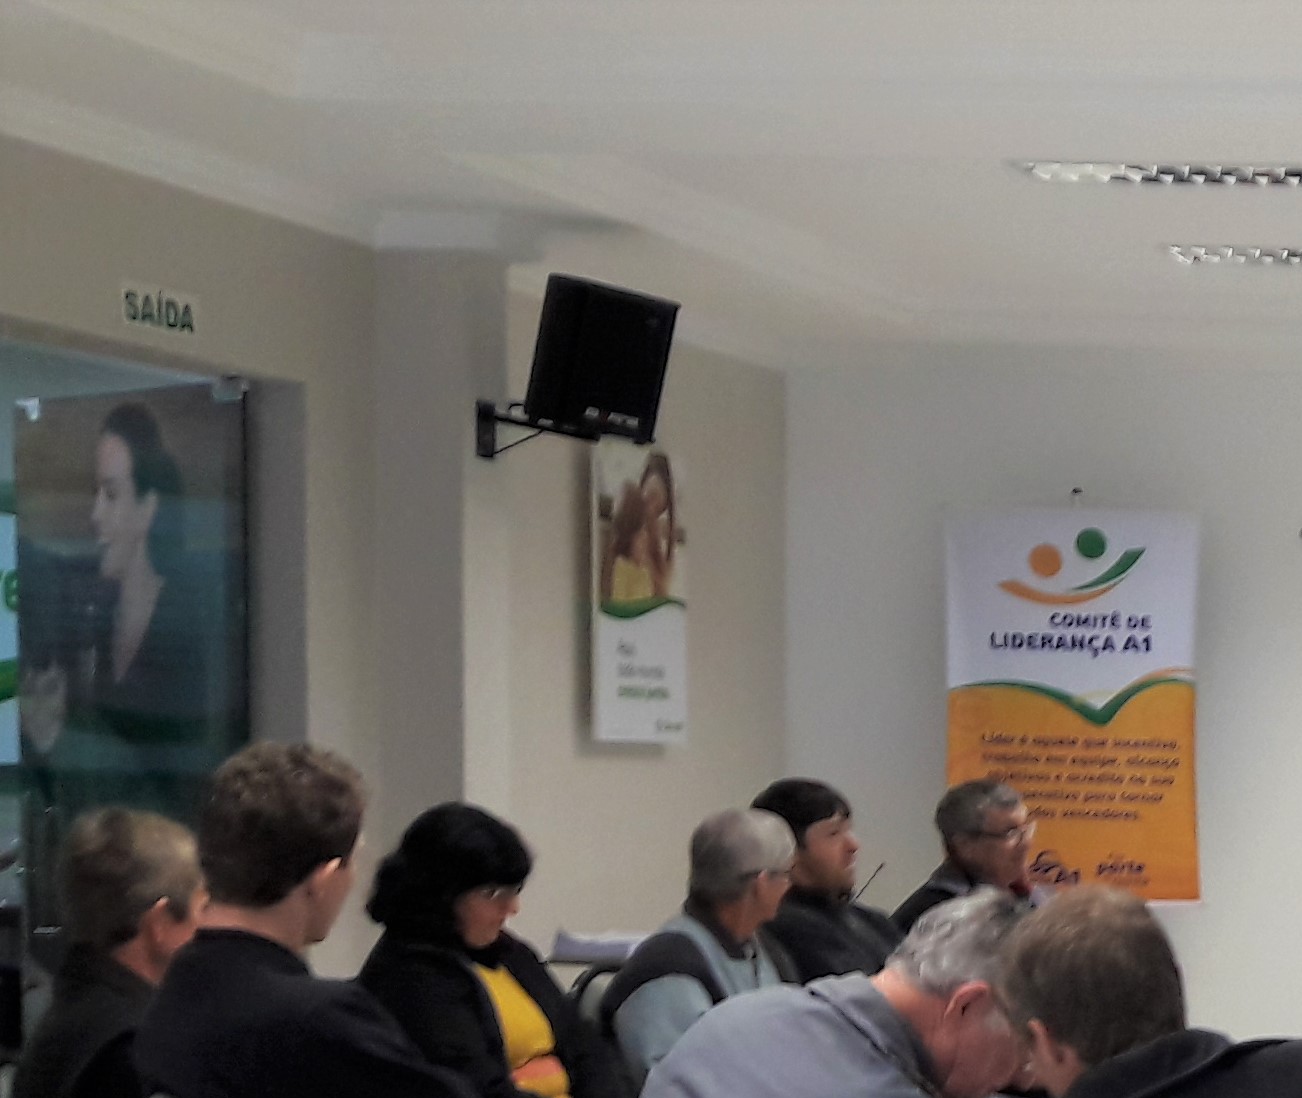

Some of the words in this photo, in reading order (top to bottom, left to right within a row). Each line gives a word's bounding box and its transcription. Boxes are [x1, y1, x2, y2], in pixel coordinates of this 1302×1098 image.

[124, 289, 194, 334] SAÍDA
[1049, 609, 1122, 630] COMITÊ
[1126, 614, 1153, 629] DE
[989, 631, 1116, 659] LIDERANÇA
[1122, 634, 1153, 654] A1
